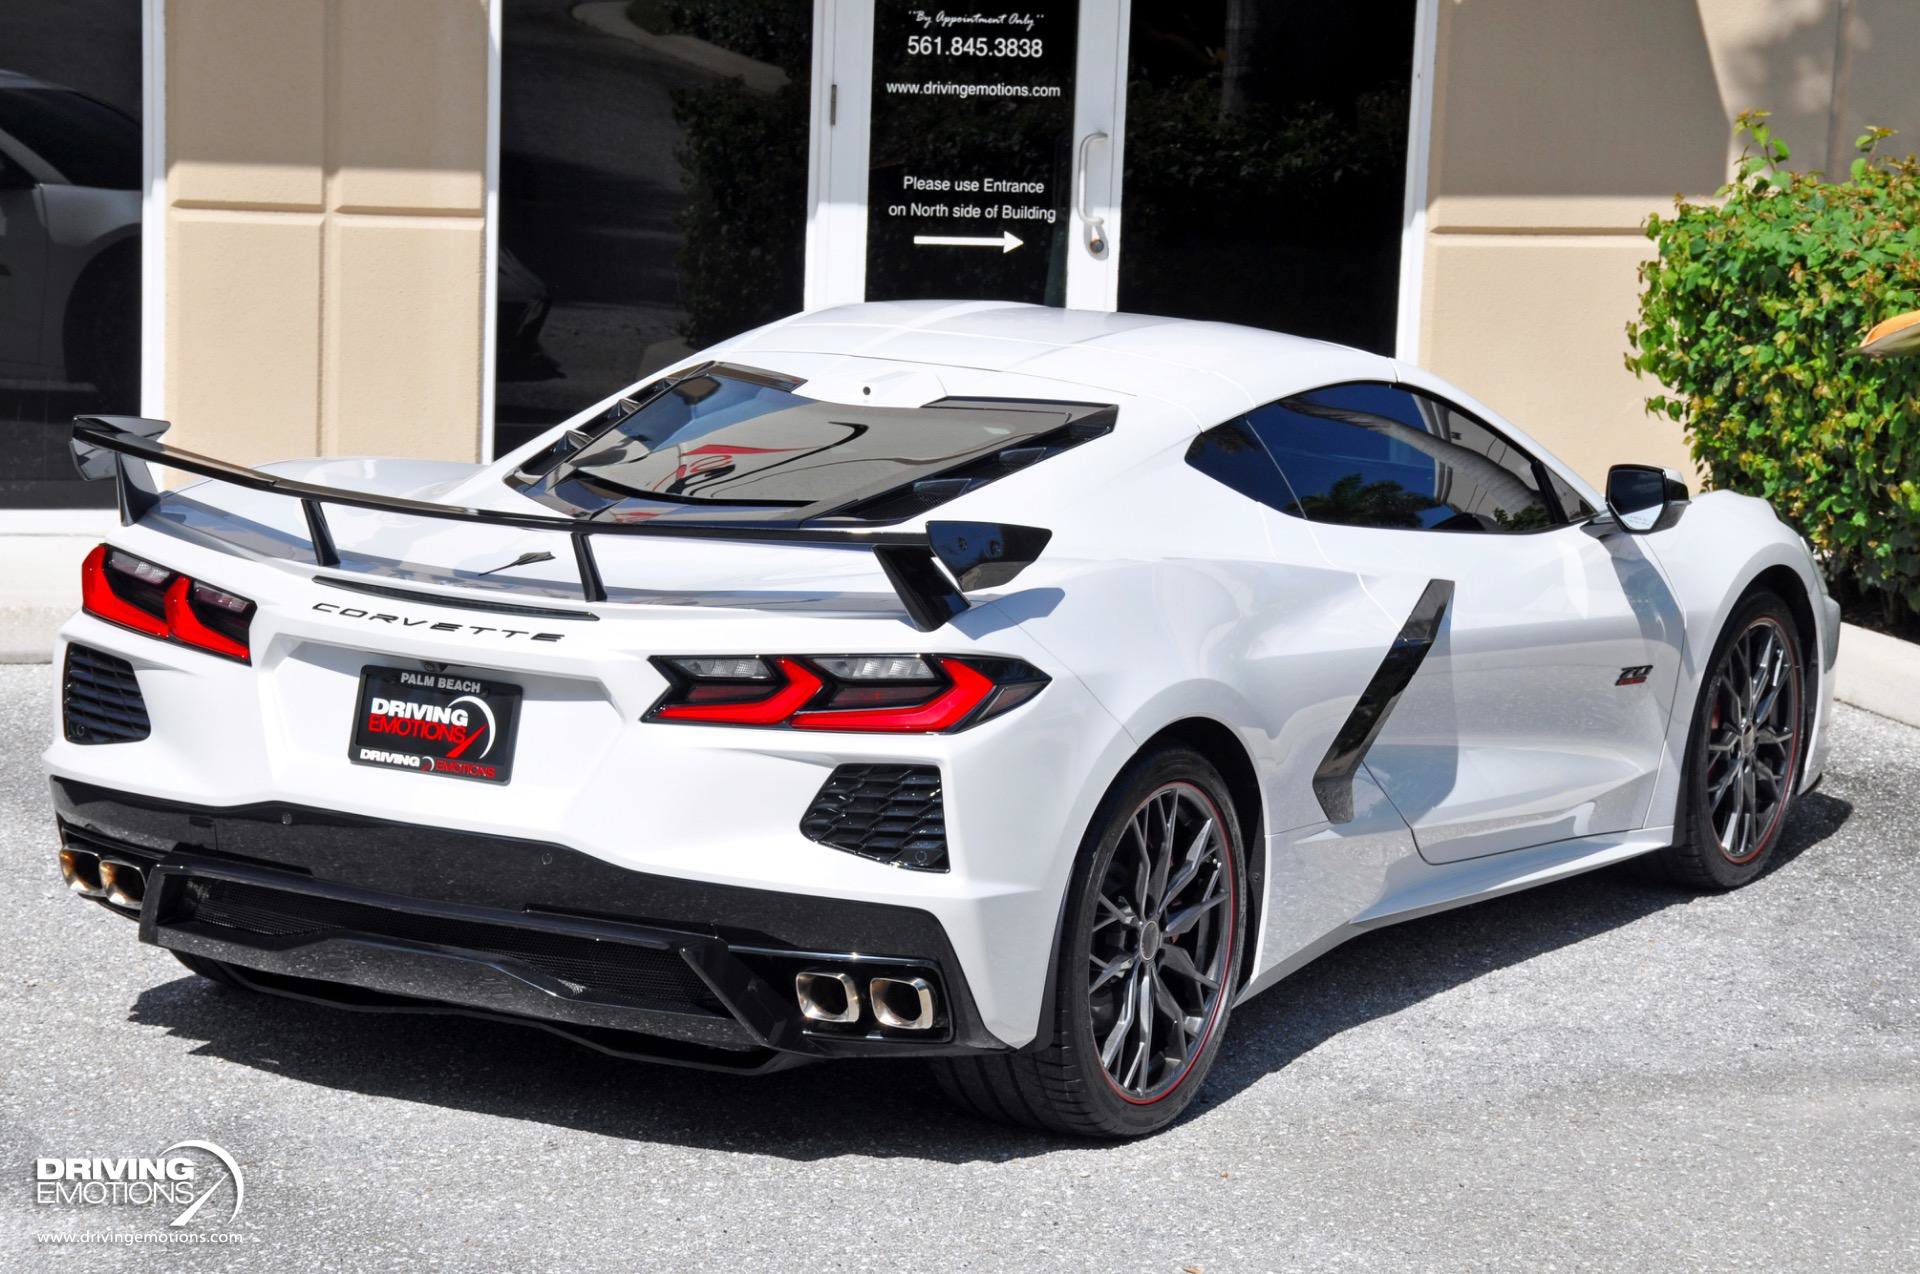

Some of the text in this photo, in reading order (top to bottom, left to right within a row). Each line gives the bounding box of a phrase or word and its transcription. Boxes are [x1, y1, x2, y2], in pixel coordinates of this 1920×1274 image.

[936, 11, 1006, 27] Appointment
[907, 36, 1043, 58] 561.845.3838
[886, 82, 1061, 99] www.drivingemotions.com
[904, 176, 1044, 193] Please use Entrance
[889, 203, 1056, 223] on North side of Building
[312, 603, 565, 642] CORVETTE
[401, 673, 480, 693] PALM BEACH
[371, 698, 468, 727] DRIVING
[368, 714, 468, 743] EMOTIONS
[360, 749, 496, 778] DRIVING EMOTIONS
